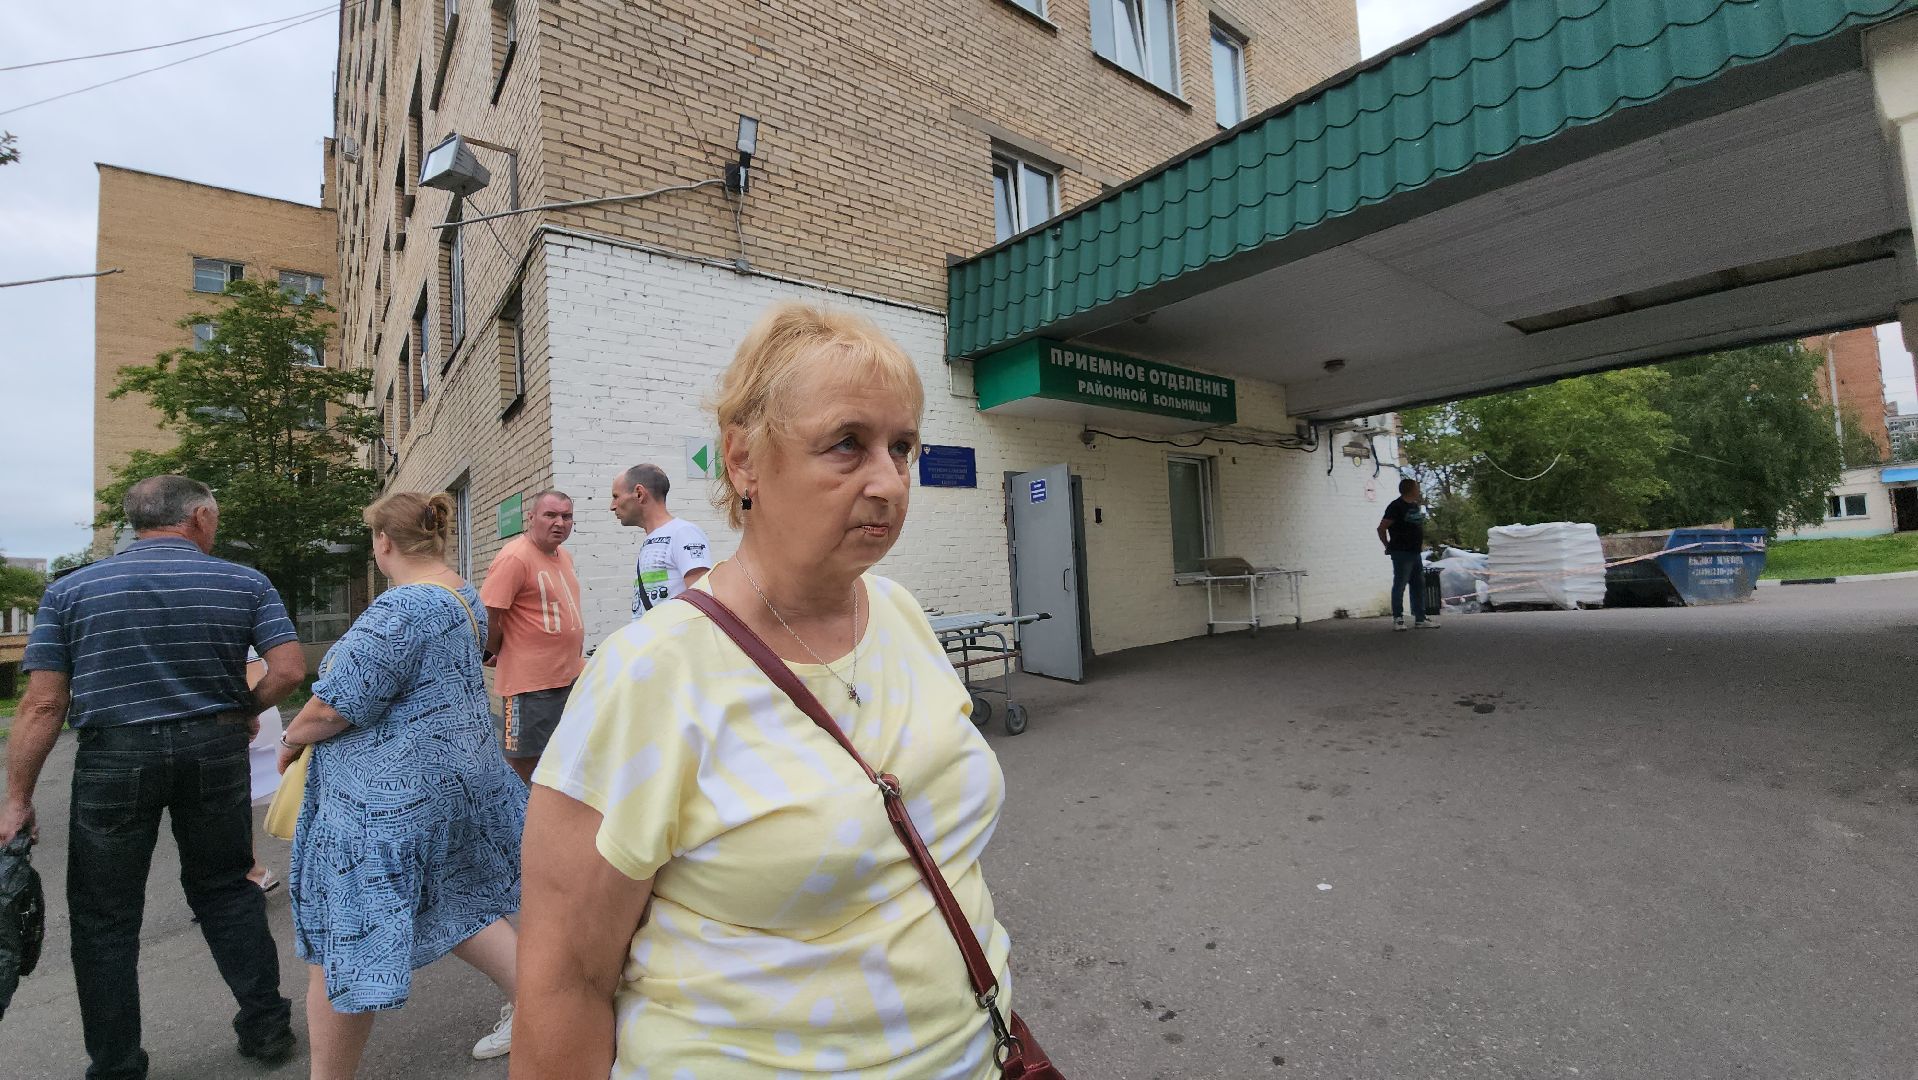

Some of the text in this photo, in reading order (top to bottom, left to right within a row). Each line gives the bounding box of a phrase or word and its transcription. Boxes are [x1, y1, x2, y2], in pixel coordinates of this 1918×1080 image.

[1050, 347, 1228, 398] ПРИЕМНОЕ ОТДЕЛЕНИЕ
[1078, 379, 1211, 415] РАЙОННОЙ БОЛЬНИЦЫ
[511, 696, 520, 737] NDER
